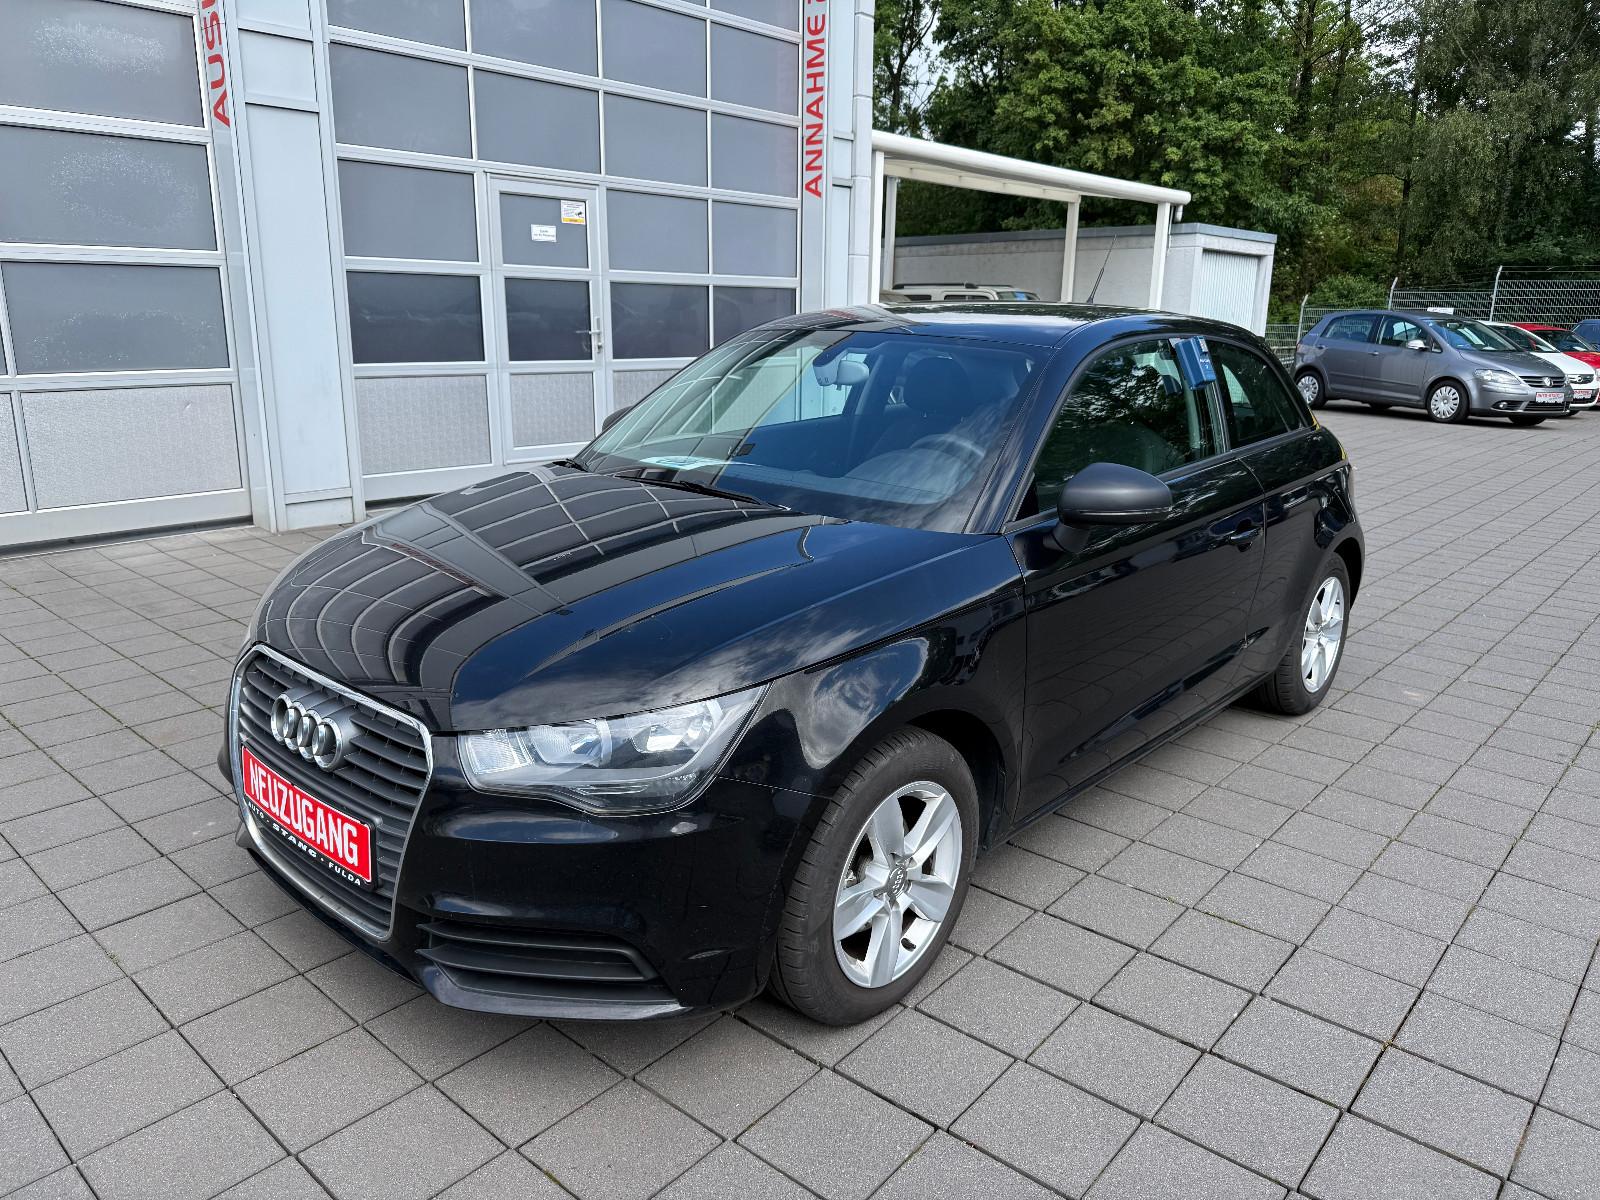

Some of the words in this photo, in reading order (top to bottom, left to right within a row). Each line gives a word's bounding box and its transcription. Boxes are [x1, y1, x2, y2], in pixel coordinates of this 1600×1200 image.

[804, 14, 826, 198] ANNAHME
[247, 801, 266, 819] AUTO
[271, 822, 317, 858] STANG
[328, 861, 361, 886] FULDA
[249, 759, 359, 867] NEUZUGANG
